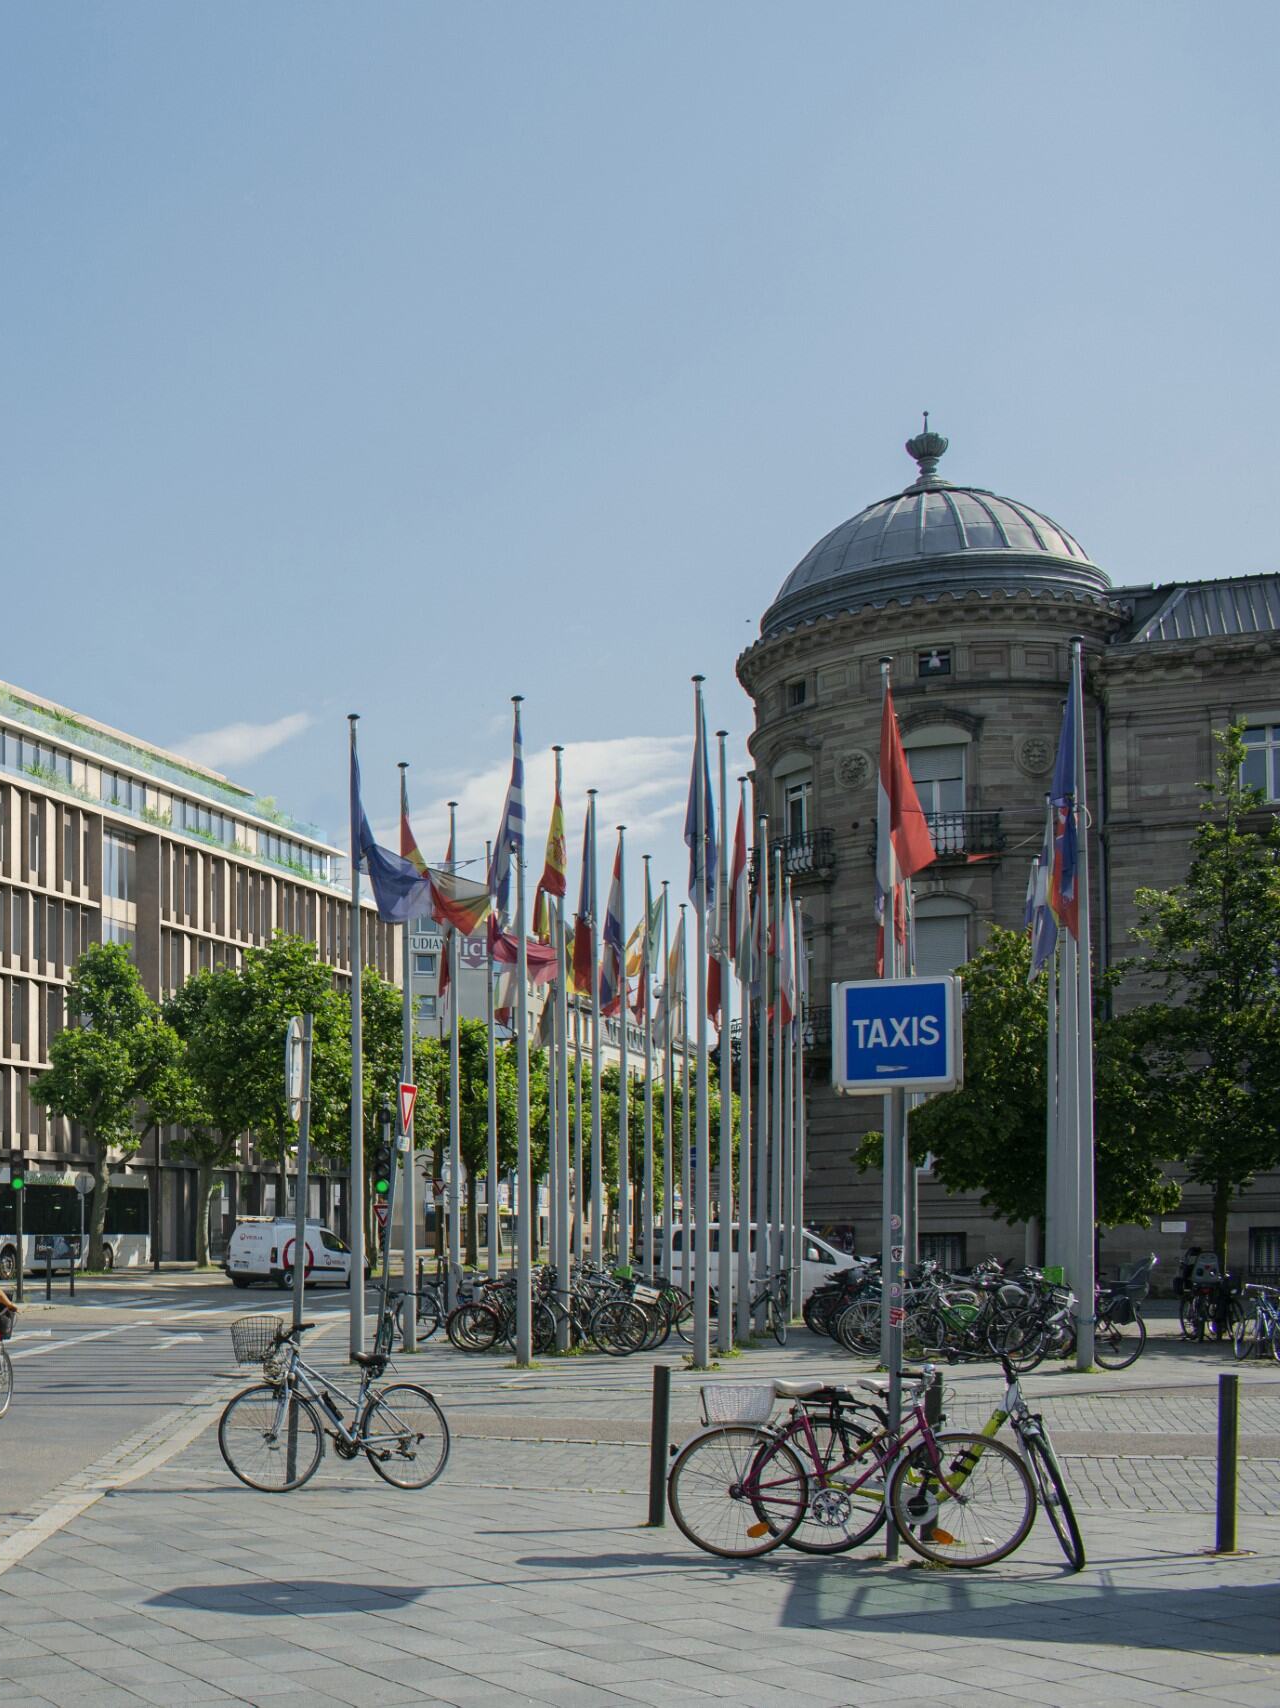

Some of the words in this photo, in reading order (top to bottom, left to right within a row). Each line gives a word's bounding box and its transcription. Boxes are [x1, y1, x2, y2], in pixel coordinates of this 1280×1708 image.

[410, 937, 443, 950] UDIA
[463, 938, 487, 956] ici
[852, 1015, 940, 1049] TAXIS
